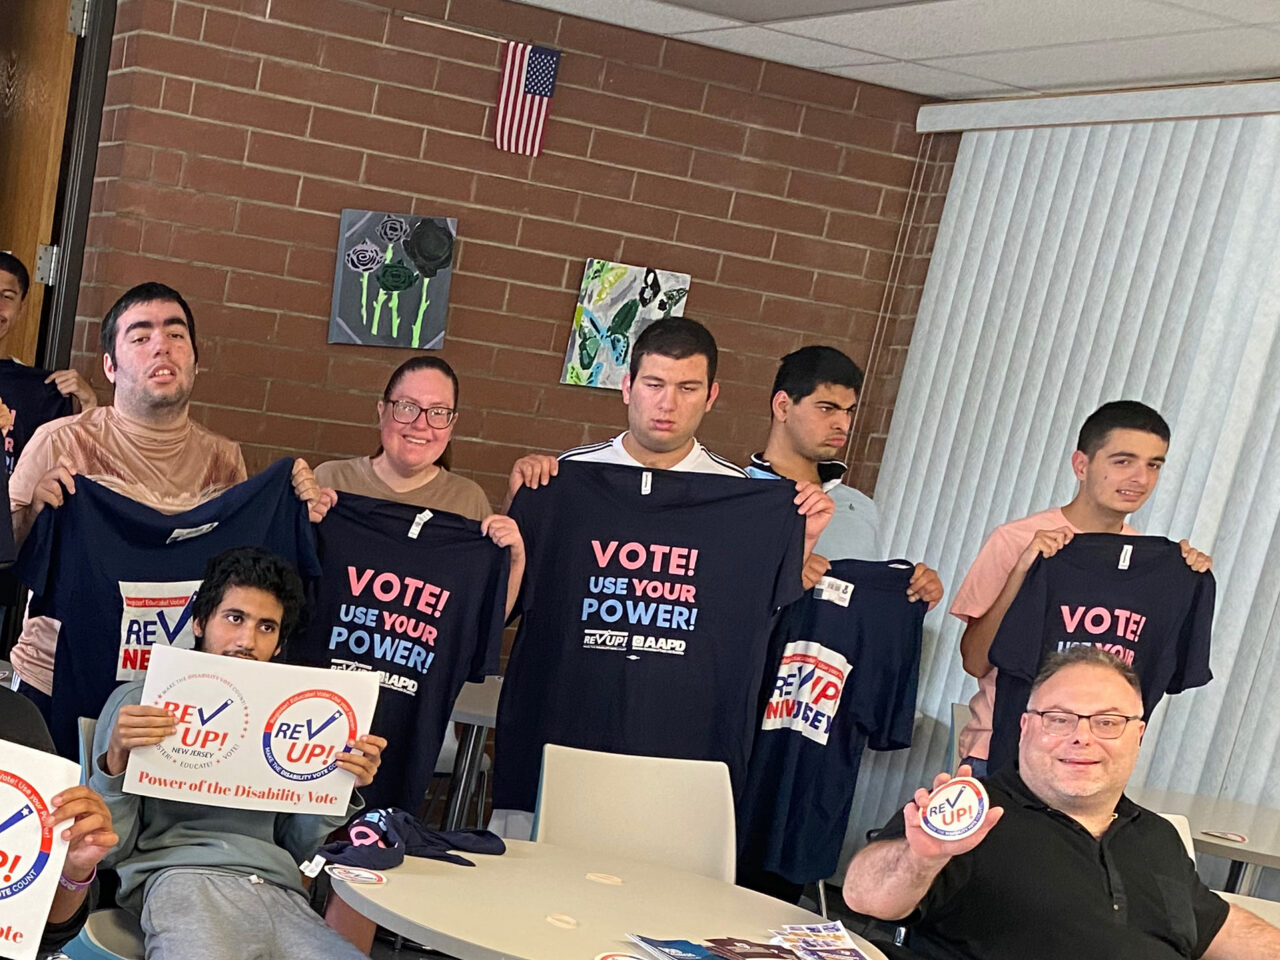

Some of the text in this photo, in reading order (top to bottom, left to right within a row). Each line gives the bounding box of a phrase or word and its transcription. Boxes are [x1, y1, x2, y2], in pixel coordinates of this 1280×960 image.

[591, 540, 698, 576] VOTE!
[347, 565, 450, 618] VOTE!
[589, 576, 696, 603] USE YOUR
[340, 604, 438, 646] USE YOUR
[581, 597, 698, 631] POWER!
[1060, 605, 1146, 642] VOTE!
[328, 626, 435, 674] POWER!
[645, 636, 686, 652] AAPD
[171, 747, 215, 759] NEW JERSEY
[180, 727, 229, 752] UP!
[179, 761, 213, 770] EDUCATE!
[222, 743, 240, 760] VOTE!
[286, 742, 335, 766] UP!
[138, 770, 338, 806] Power of the Disability Vote
[280, 770, 312, 780] DISABILITY
[312, 769, 329, 779] VOTE
[18, 781, 31, 796] Use
[29, 793, 44, 811] your
[942, 805, 973, 826] UP!
[12, 869, 38, 893] COUNT
